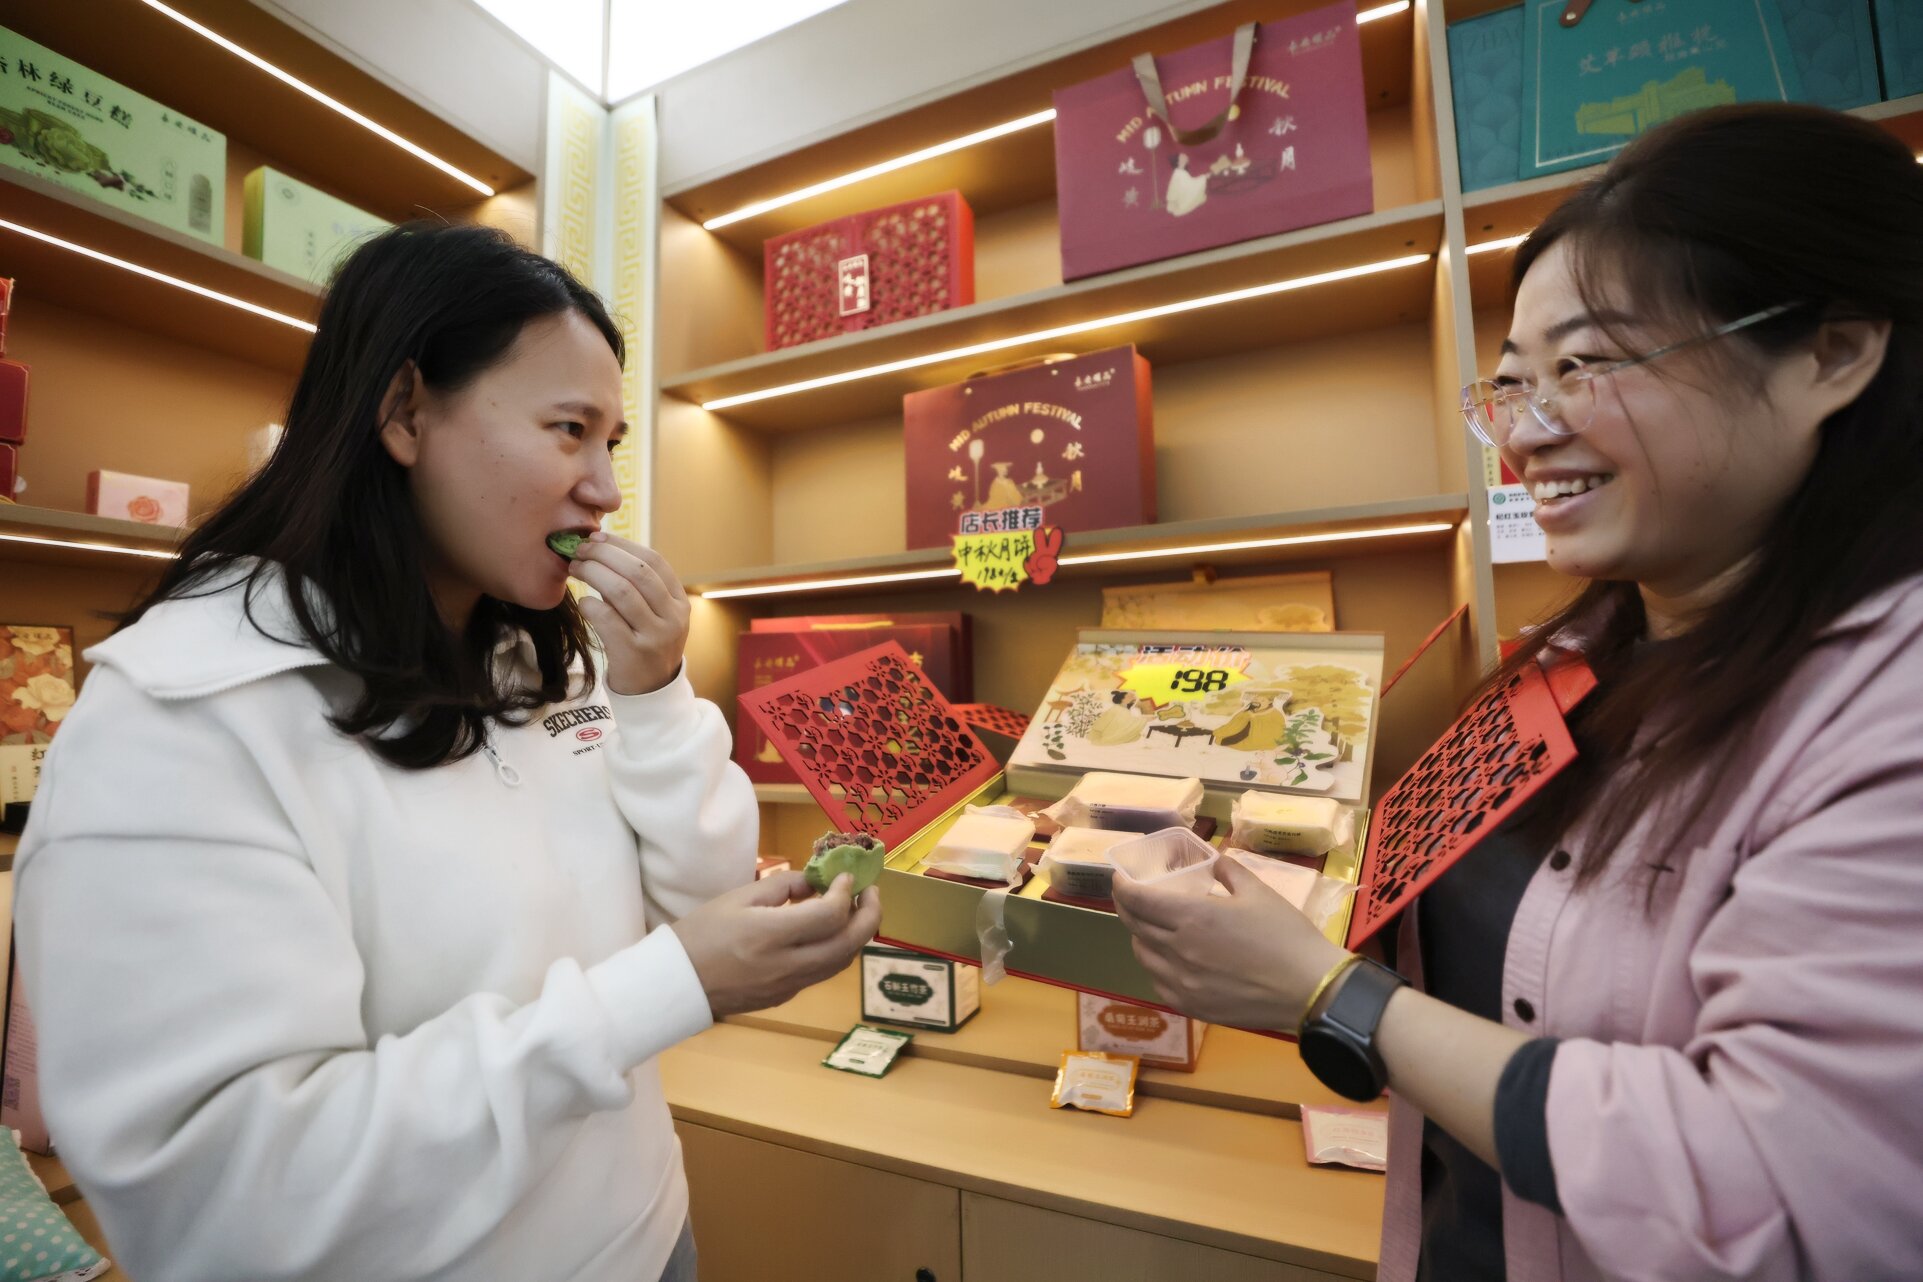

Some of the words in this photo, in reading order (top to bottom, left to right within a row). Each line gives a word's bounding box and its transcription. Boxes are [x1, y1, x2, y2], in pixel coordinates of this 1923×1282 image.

[1116, 115, 1143, 143] MID
[1214, 74, 1291, 99] FETIVAL
[949, 429, 971, 452] MID
[972, 403, 1020, 432] AUTUMN
[1023, 402, 1082, 430] FESTIVAL
[961, 508, 1041, 533] 店长推荐
[958, 535, 1031, 567] 中秋月饼
[1170, 669, 1229, 693] 198
